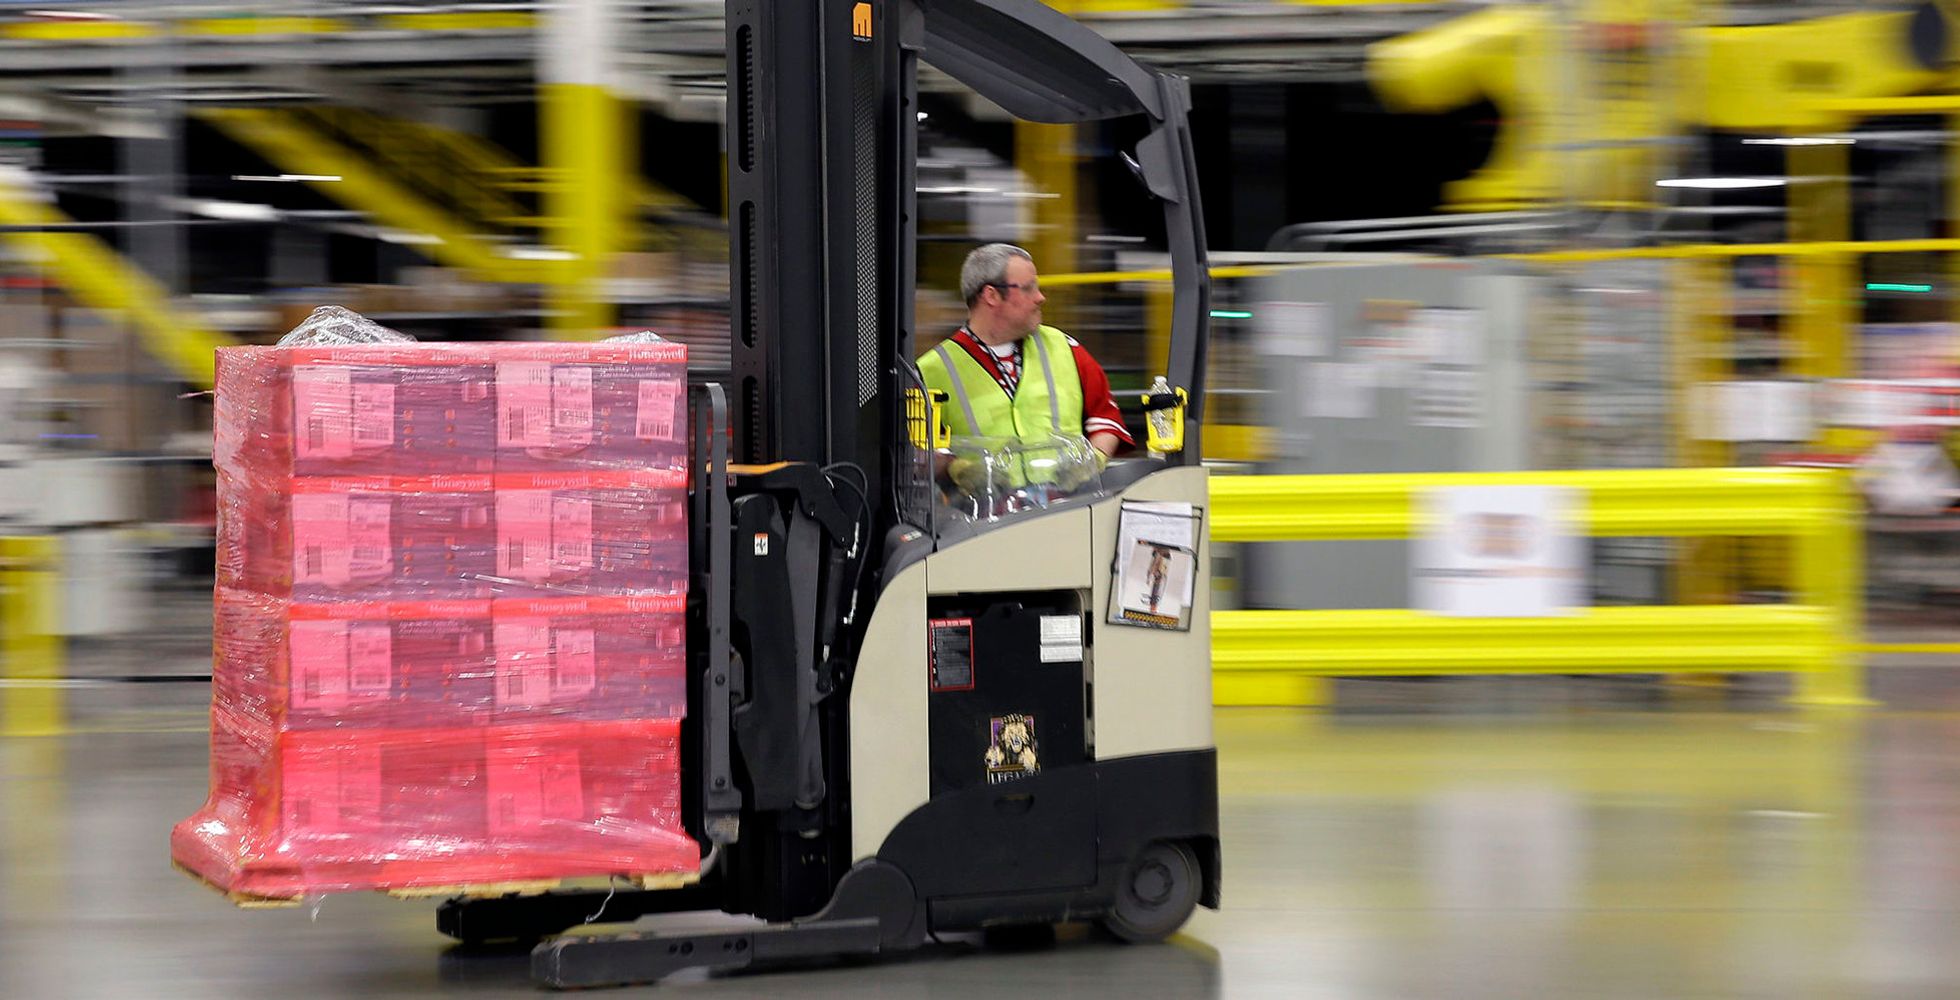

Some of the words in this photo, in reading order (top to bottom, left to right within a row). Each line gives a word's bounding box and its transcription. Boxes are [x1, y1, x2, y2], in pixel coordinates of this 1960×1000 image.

[630, 349, 685, 362] Honeywell
[431, 477, 490, 490] Honeywell
[532, 475, 589, 489] Honeywell
[529, 600, 588, 614] Honeywell
[627, 597, 683, 612] Honeywell
